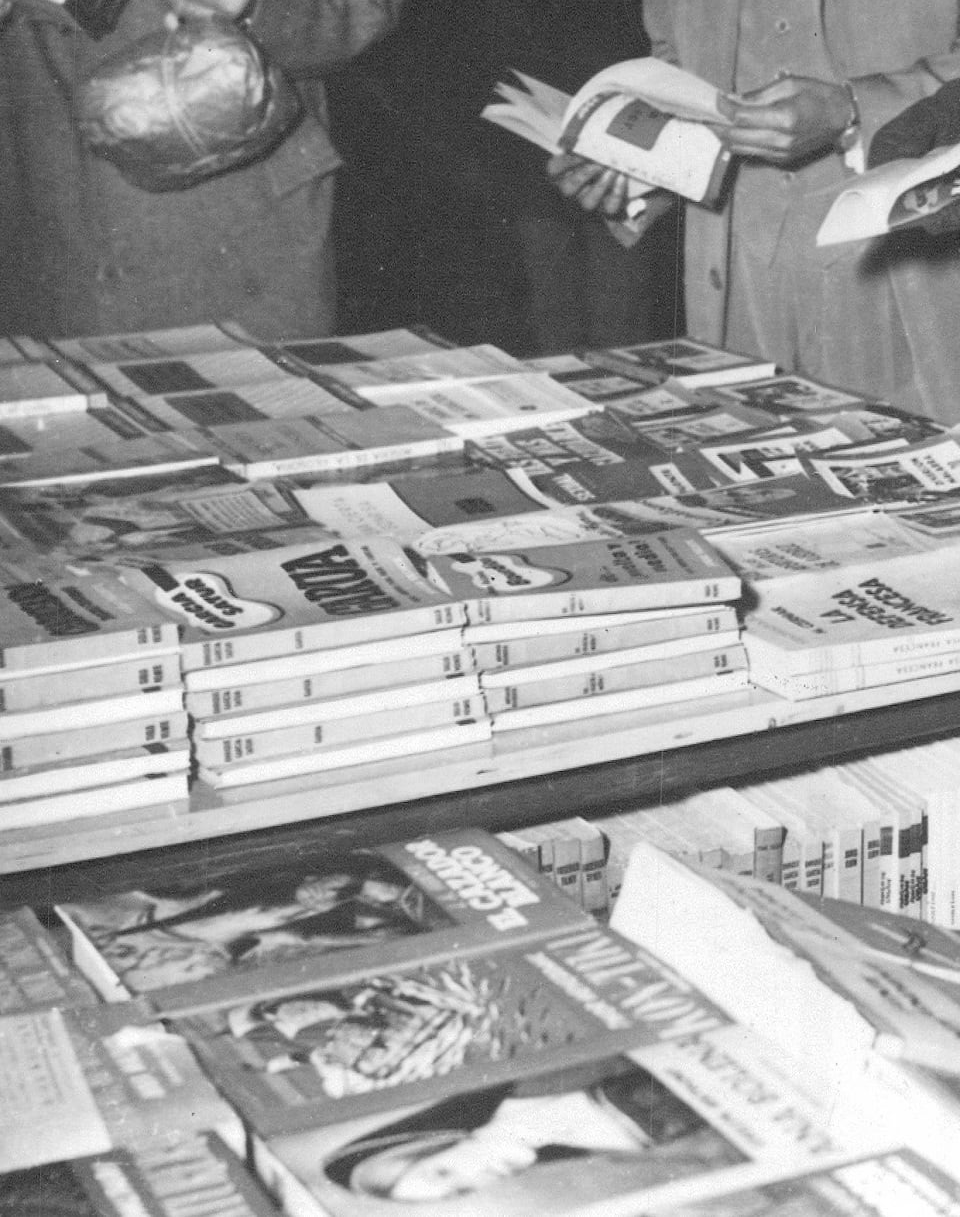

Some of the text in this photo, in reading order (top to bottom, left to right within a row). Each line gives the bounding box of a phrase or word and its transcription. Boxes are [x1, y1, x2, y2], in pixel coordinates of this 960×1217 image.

[819, 609, 855, 624] LA
[830, 589, 916, 629] DEFENSA
[857, 578, 954, 626] FRANCESA
